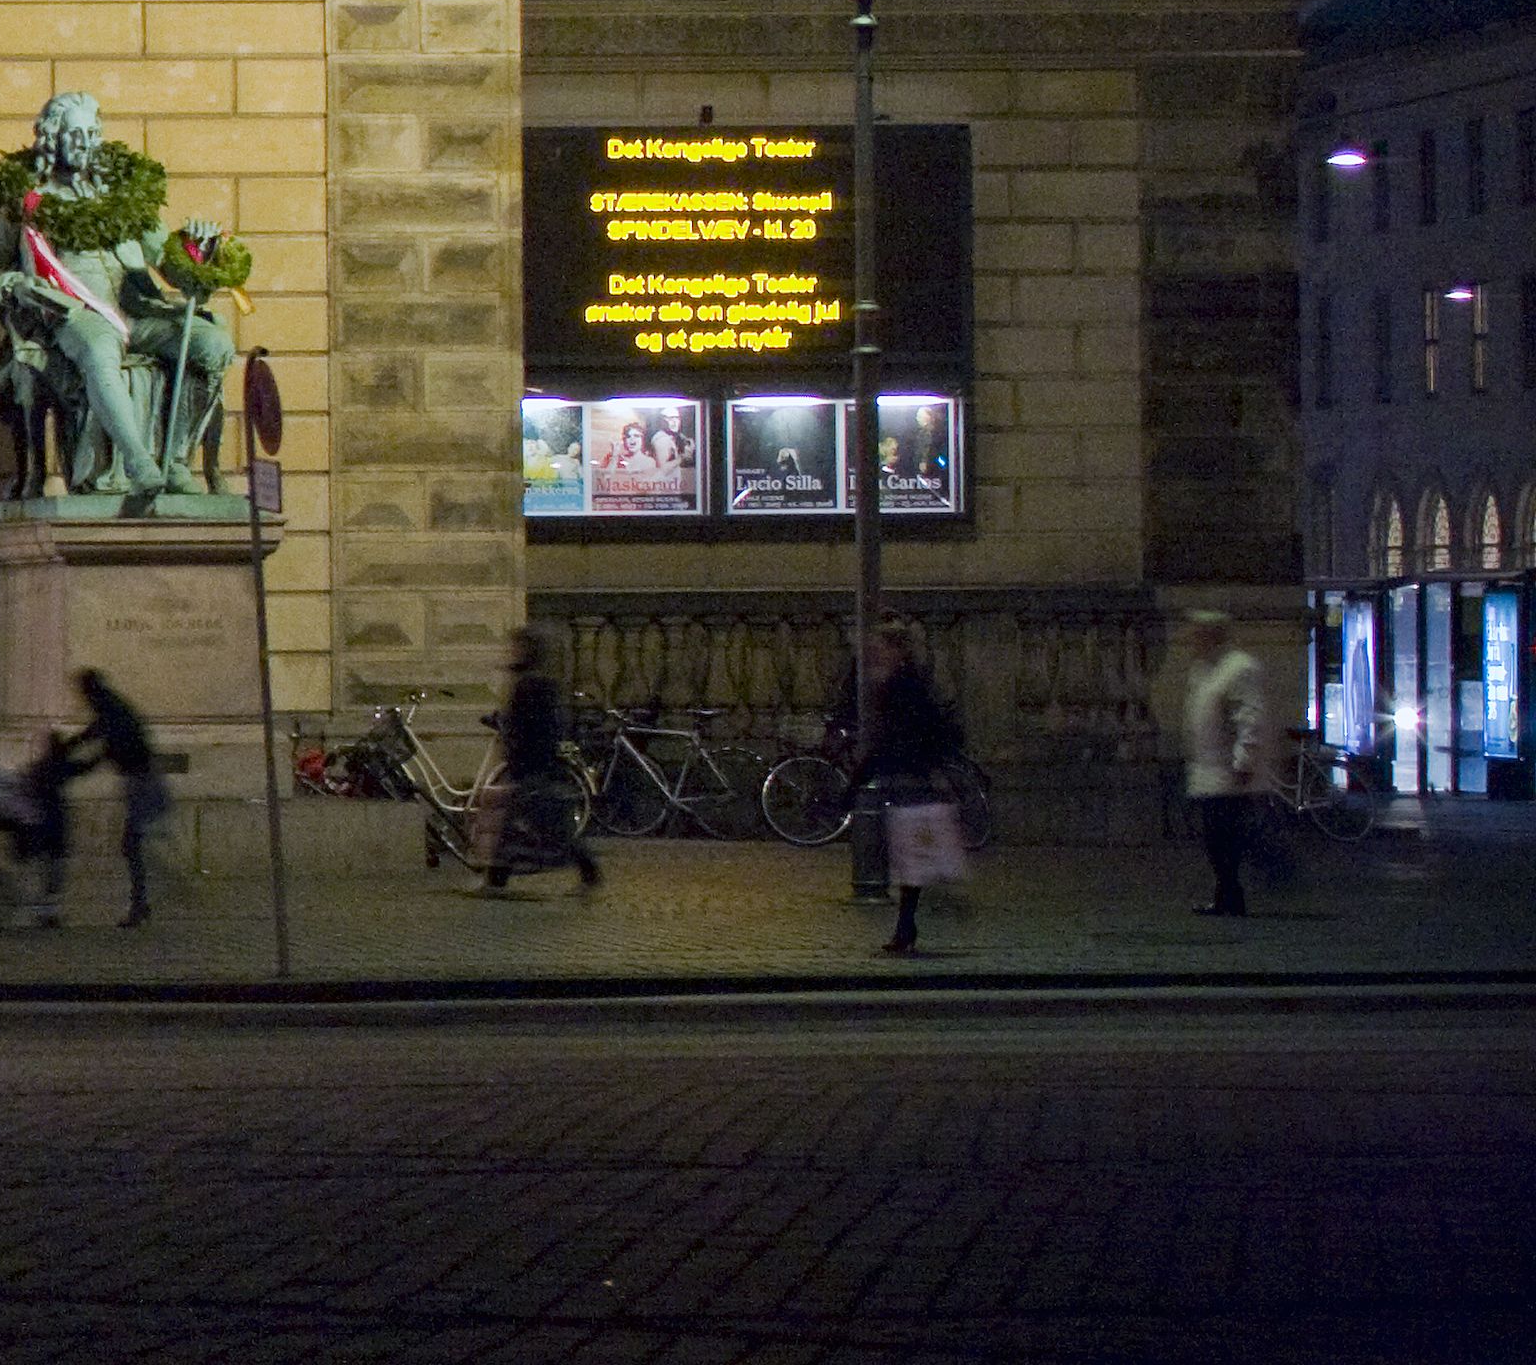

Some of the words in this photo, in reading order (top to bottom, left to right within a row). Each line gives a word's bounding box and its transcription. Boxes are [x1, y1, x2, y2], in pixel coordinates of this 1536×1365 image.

[607, 138, 644, 159] Det
[646, 137, 749, 162] Kongelige
[750, 137, 817, 159] Teater
[789, 219, 817, 239] 20
[608, 274, 645, 296] Det
[647, 273, 750, 299] Kongelige
[751, 272, 818, 294] Teater
[584, 302, 656, 323] ønsker
[657, 300, 694, 322] alle
[696, 304, 724, 322] en
[813, 299, 841, 325] jul
[634, 330, 664, 353] og
[665, 328, 688, 349] et
[688, 327, 737, 353] godt
[739, 325, 793, 352] nytår
[595, 477, 688, 493] Maskarade
[736, 474, 782, 492] Lucio
[784, 474, 822, 491] Silla
